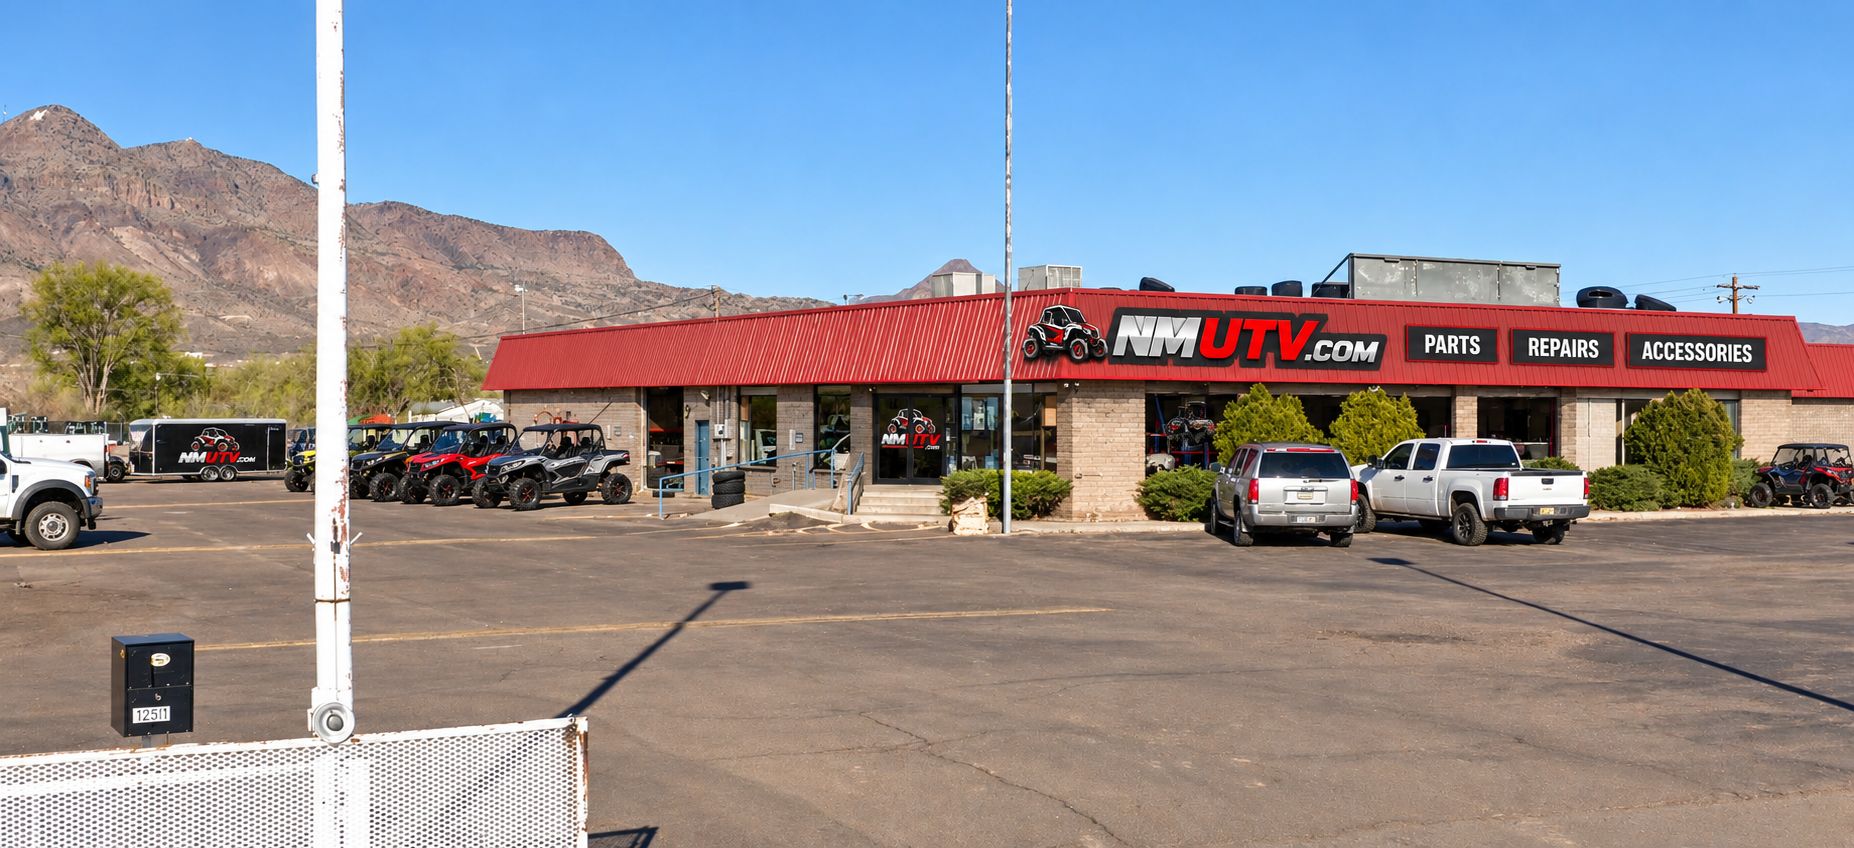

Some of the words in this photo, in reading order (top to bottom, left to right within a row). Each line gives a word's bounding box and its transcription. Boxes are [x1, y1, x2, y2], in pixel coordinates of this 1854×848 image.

[1112, 315, 1379, 363] NMUTV.COM
[1424, 334, 1481, 355] PARTS
[1528, 337, 1599, 359] REPAIRS
[1641, 341, 1752, 363] ACCESSORIES
